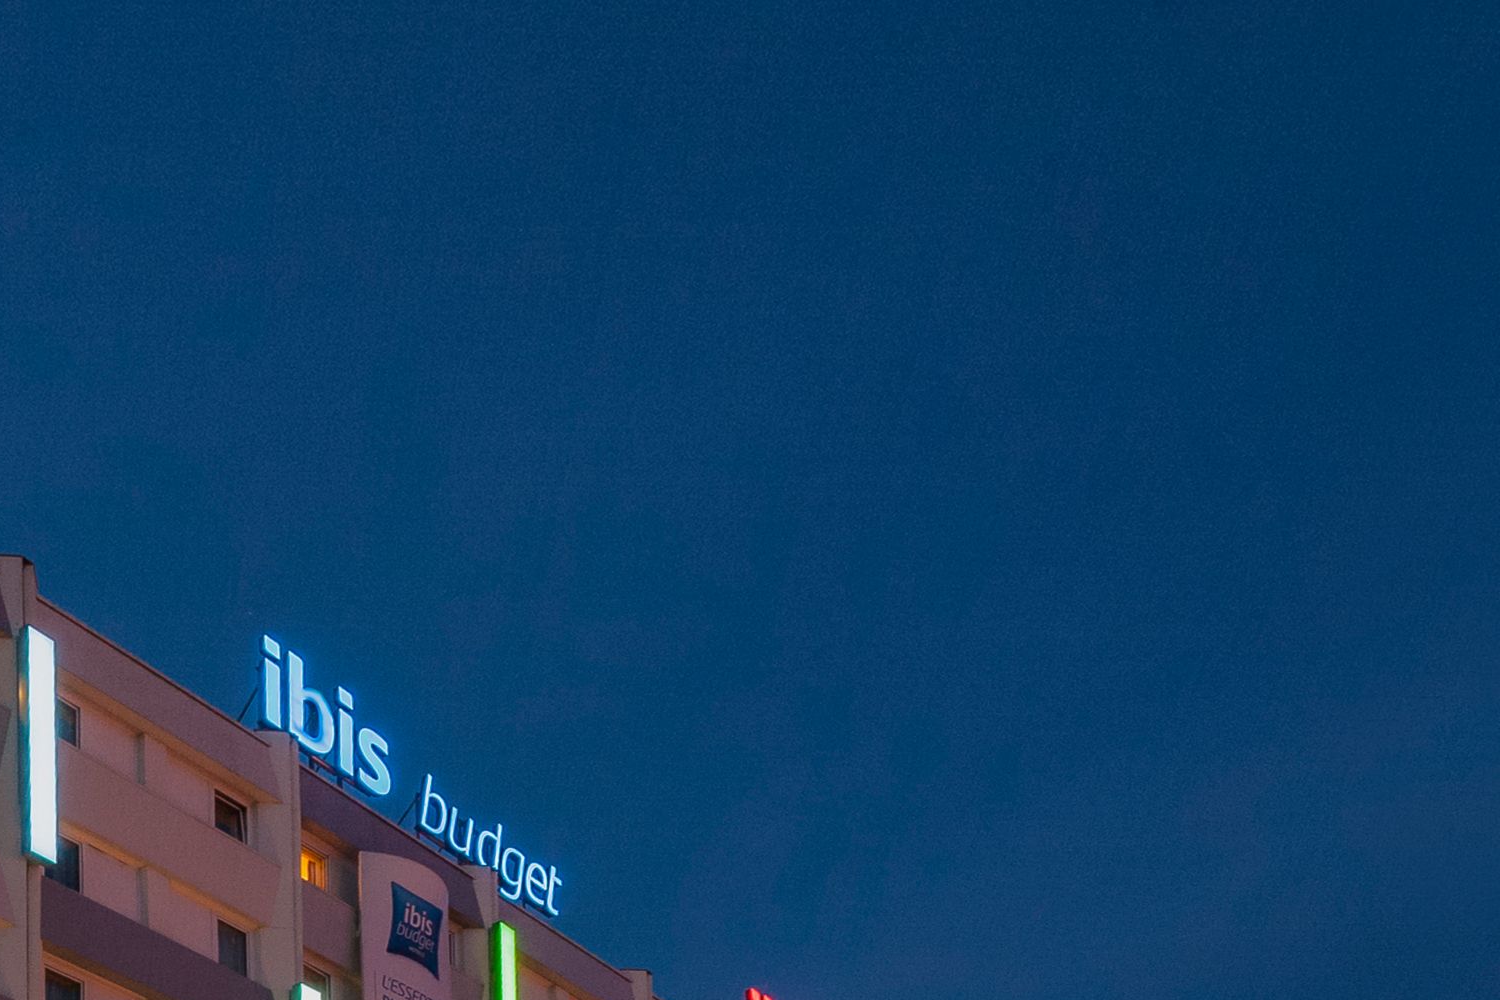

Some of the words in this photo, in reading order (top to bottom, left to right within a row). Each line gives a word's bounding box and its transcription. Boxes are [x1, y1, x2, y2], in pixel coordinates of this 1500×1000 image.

[262, 633, 392, 796] ibis
[418, 773, 564, 917] budget
[396, 920, 435, 953] budget
[403, 902, 434, 938] ibis
